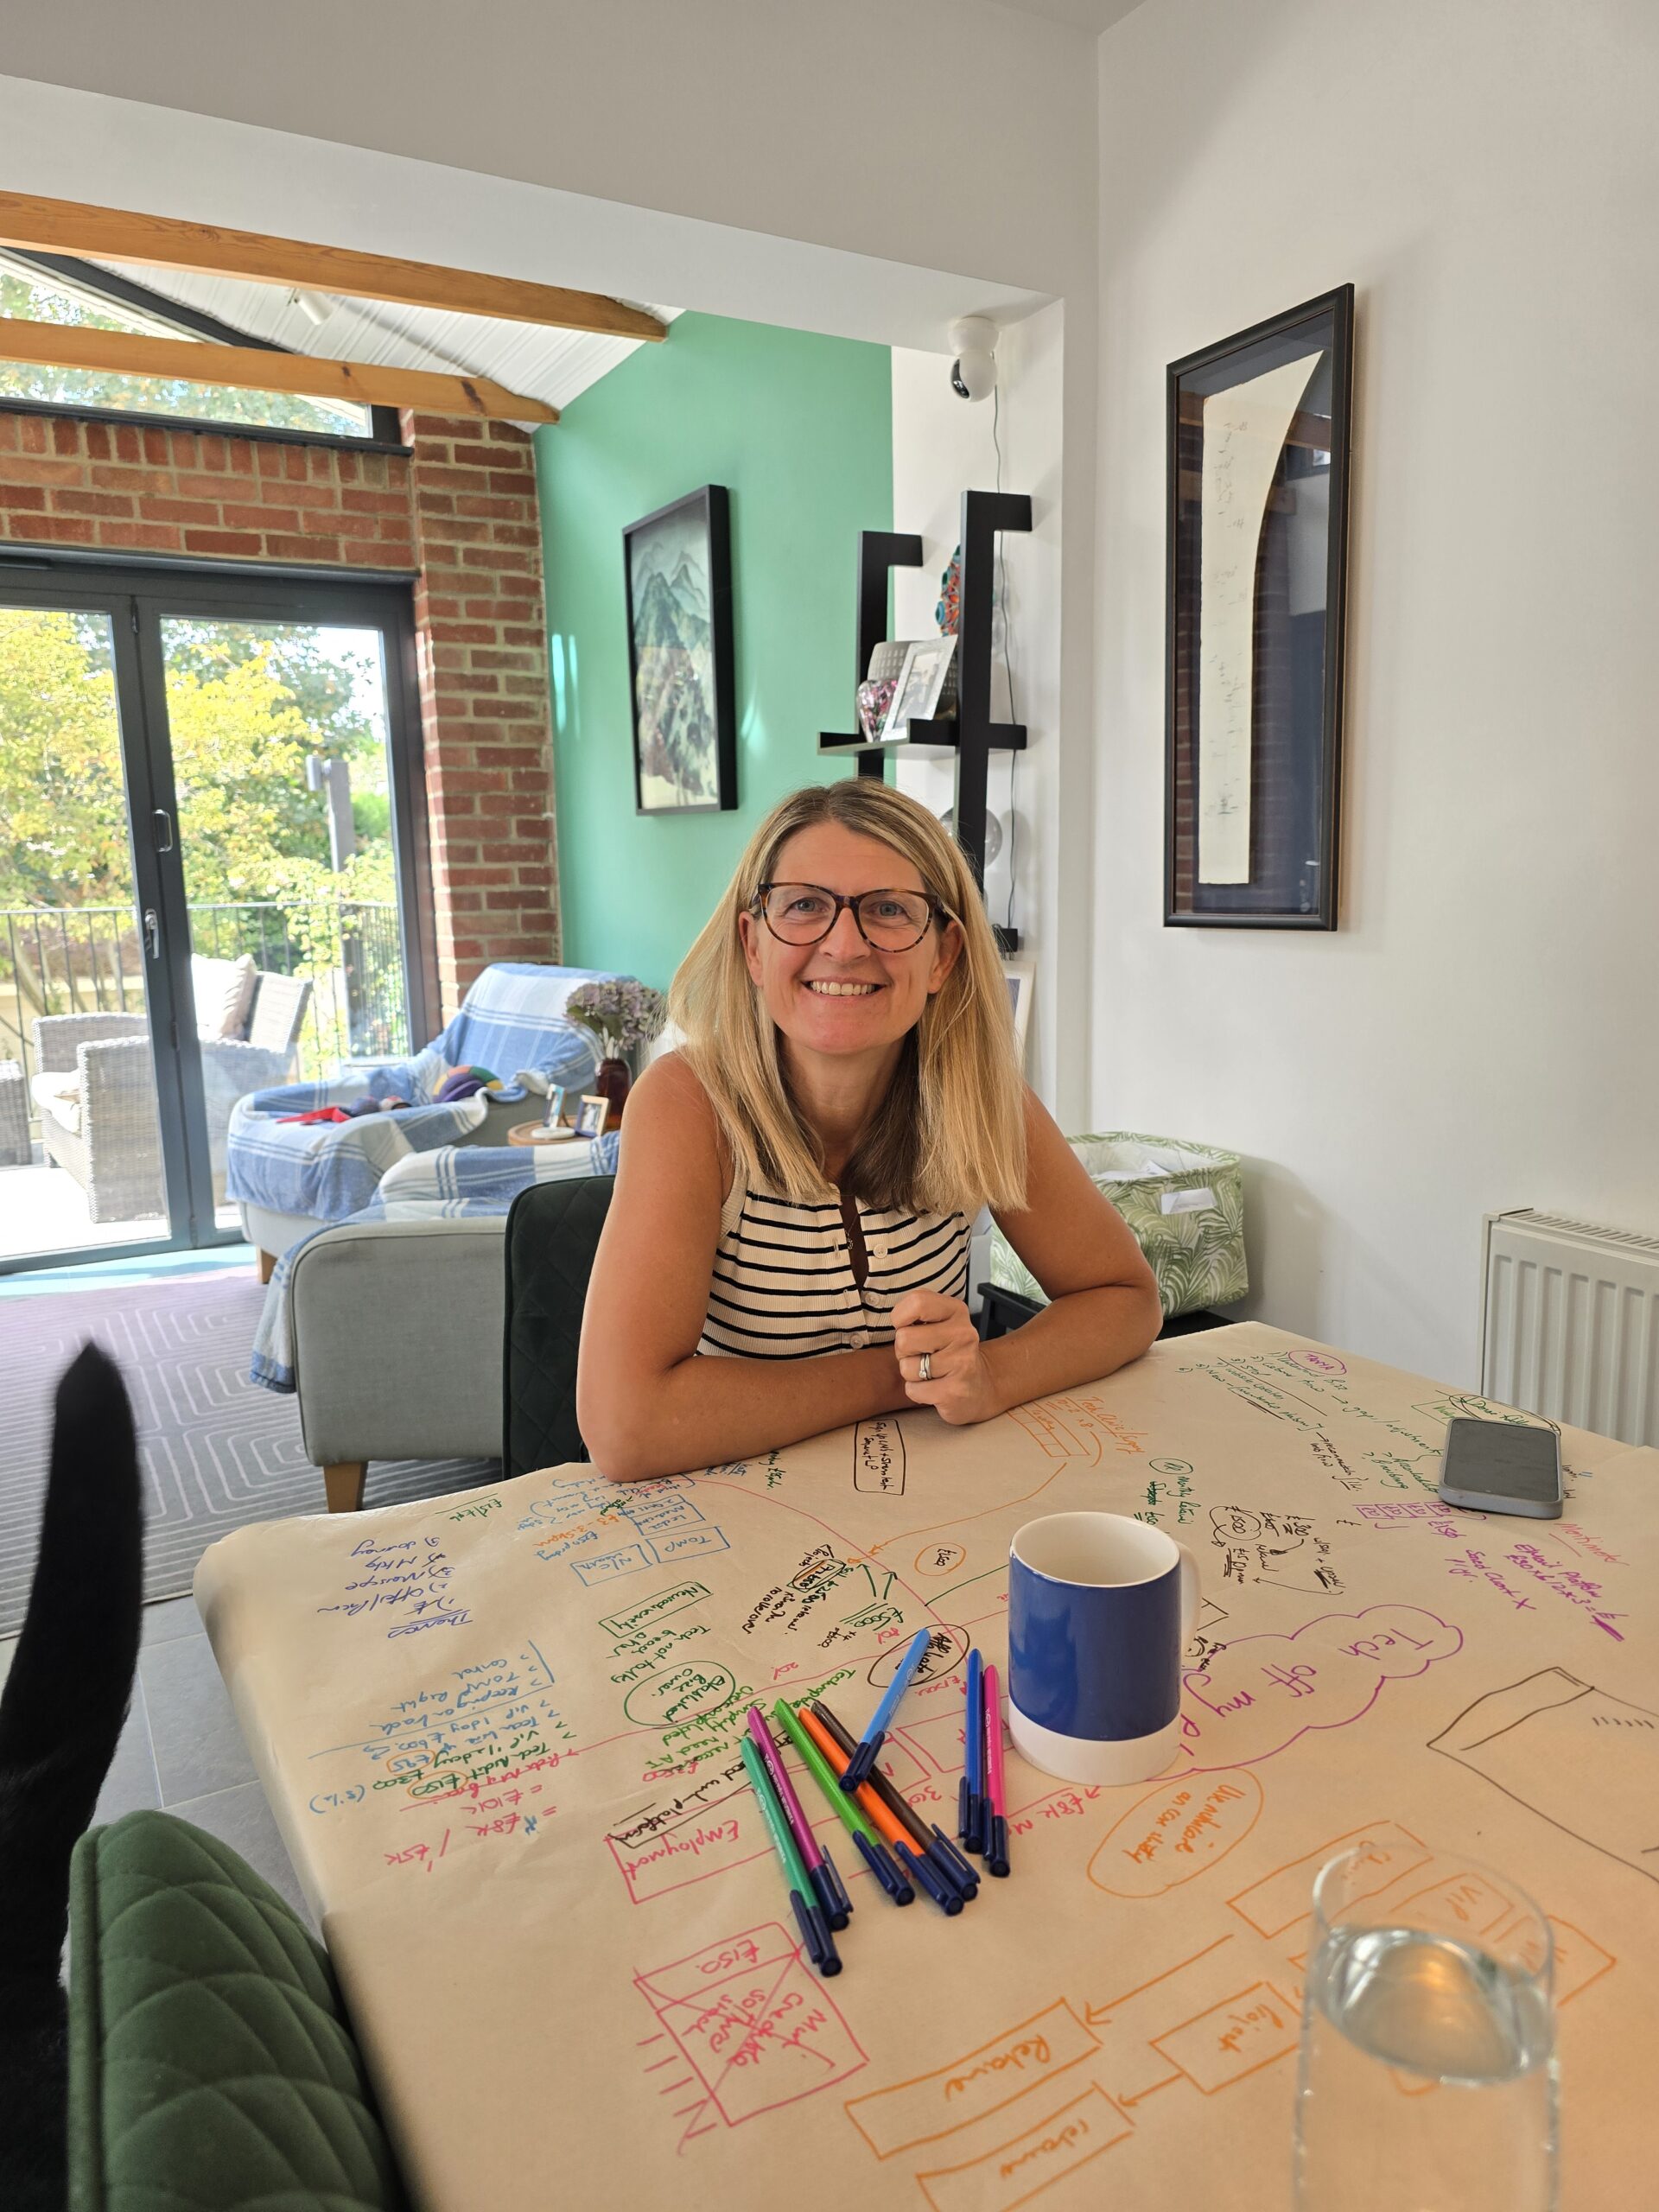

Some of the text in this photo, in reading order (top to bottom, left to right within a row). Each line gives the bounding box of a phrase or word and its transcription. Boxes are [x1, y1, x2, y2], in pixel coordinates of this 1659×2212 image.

[1183, 1628, 1434, 1719] Tech off my
